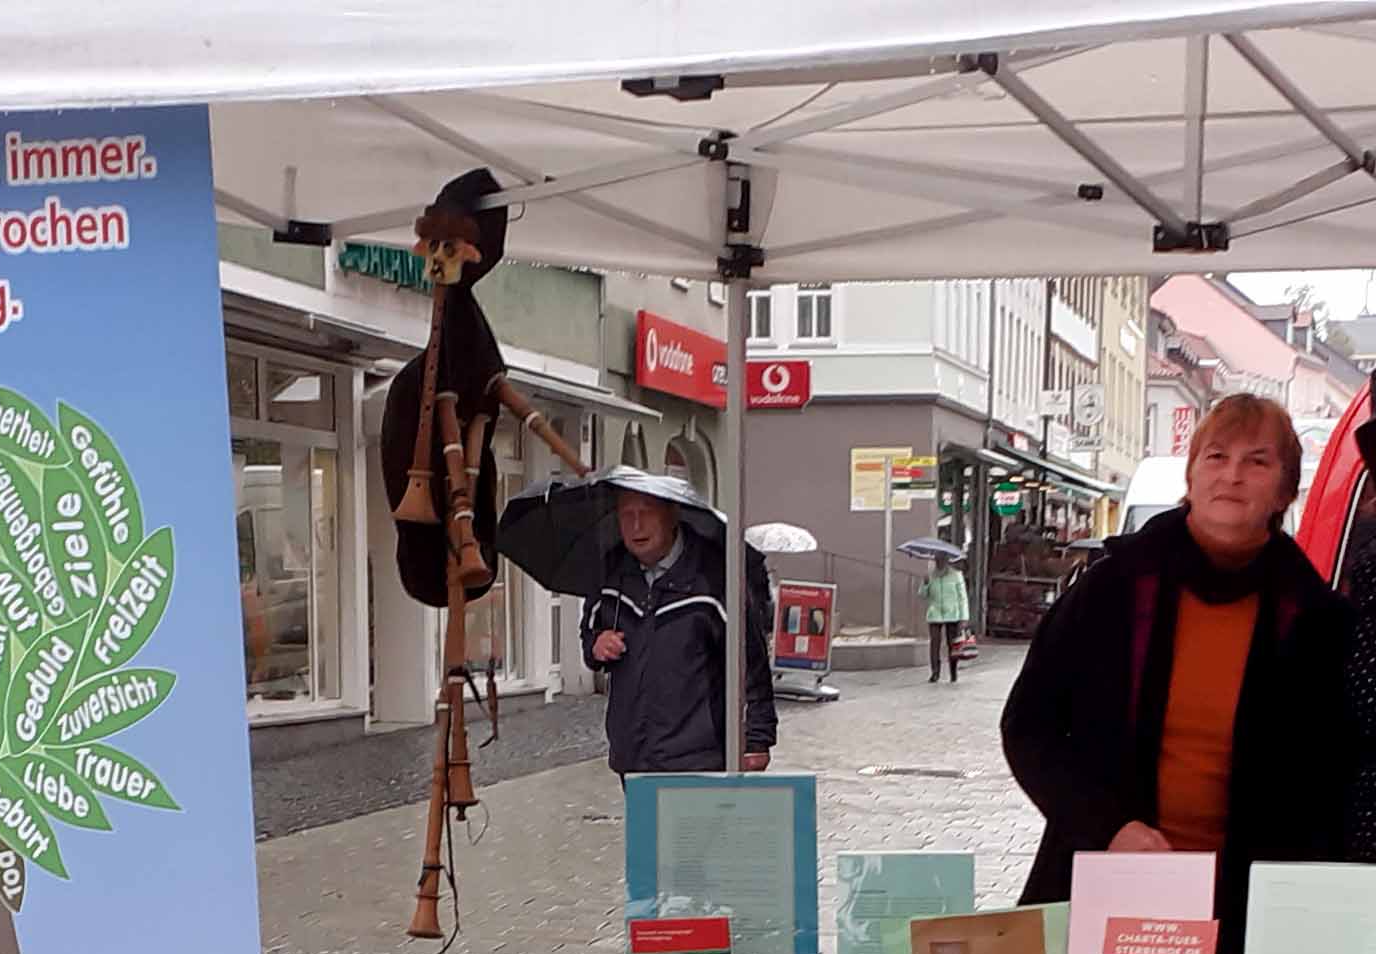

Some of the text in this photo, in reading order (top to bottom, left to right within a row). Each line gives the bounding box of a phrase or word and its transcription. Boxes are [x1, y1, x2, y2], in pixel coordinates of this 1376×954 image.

[9, 136, 154, 180] immer.
[659, 341, 694, 376] vodafone
[750, 394, 801, 405] vodafone
[71, 425, 129, 544] Gefühle
[52, 493, 97, 598] Ziele
[94, 554, 168, 664] Freizeit
[16, 636, 74, 741] Geduld
[57, 675, 157, 741] Zuversicht
[24, 761, 89, 817] Liebe
[75, 748, 157, 799] Trauer
